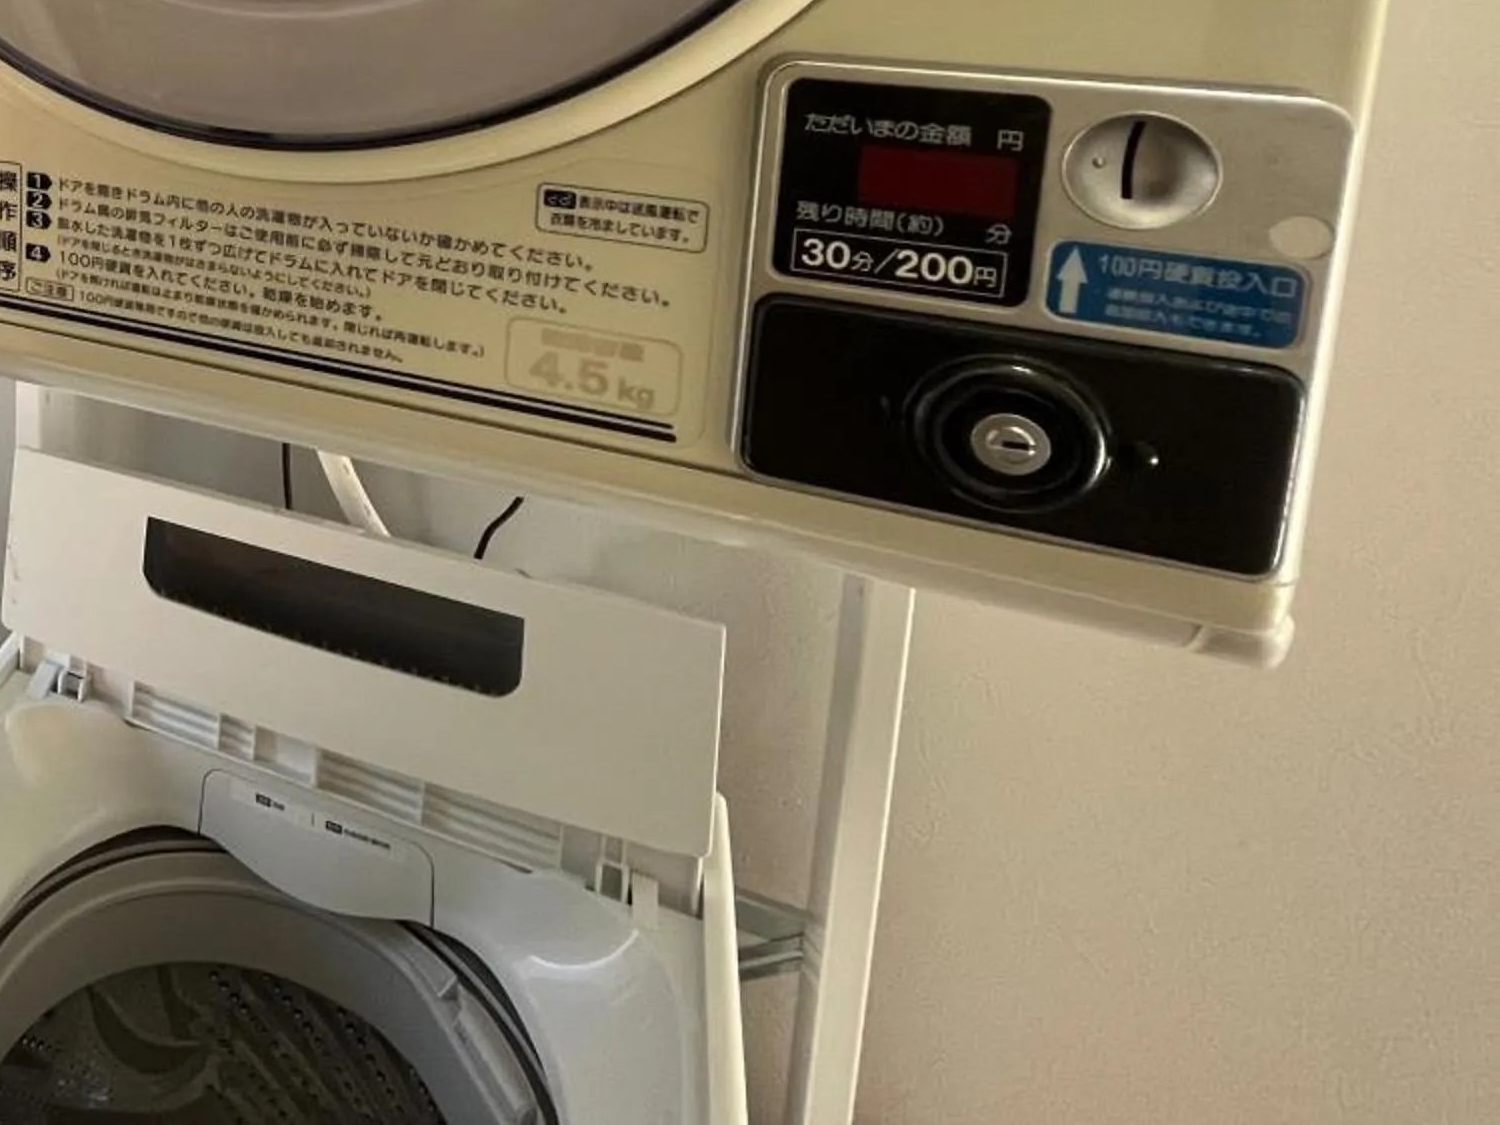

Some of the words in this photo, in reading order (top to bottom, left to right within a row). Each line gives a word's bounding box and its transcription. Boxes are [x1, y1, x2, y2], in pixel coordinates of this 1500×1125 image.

[805, 112, 972, 147] ただいまの金額
[997, 128, 1024, 151] 円
[796, 200, 945, 236] 残り時間(約)
[985, 223, 1012, 245] 分
[801, 238, 997, 288] 30分/200円
[1099, 253, 1297, 297] 100円硬貨投入口
[529, 351, 609, 397] 4.5
[618, 377, 656, 410] kg
